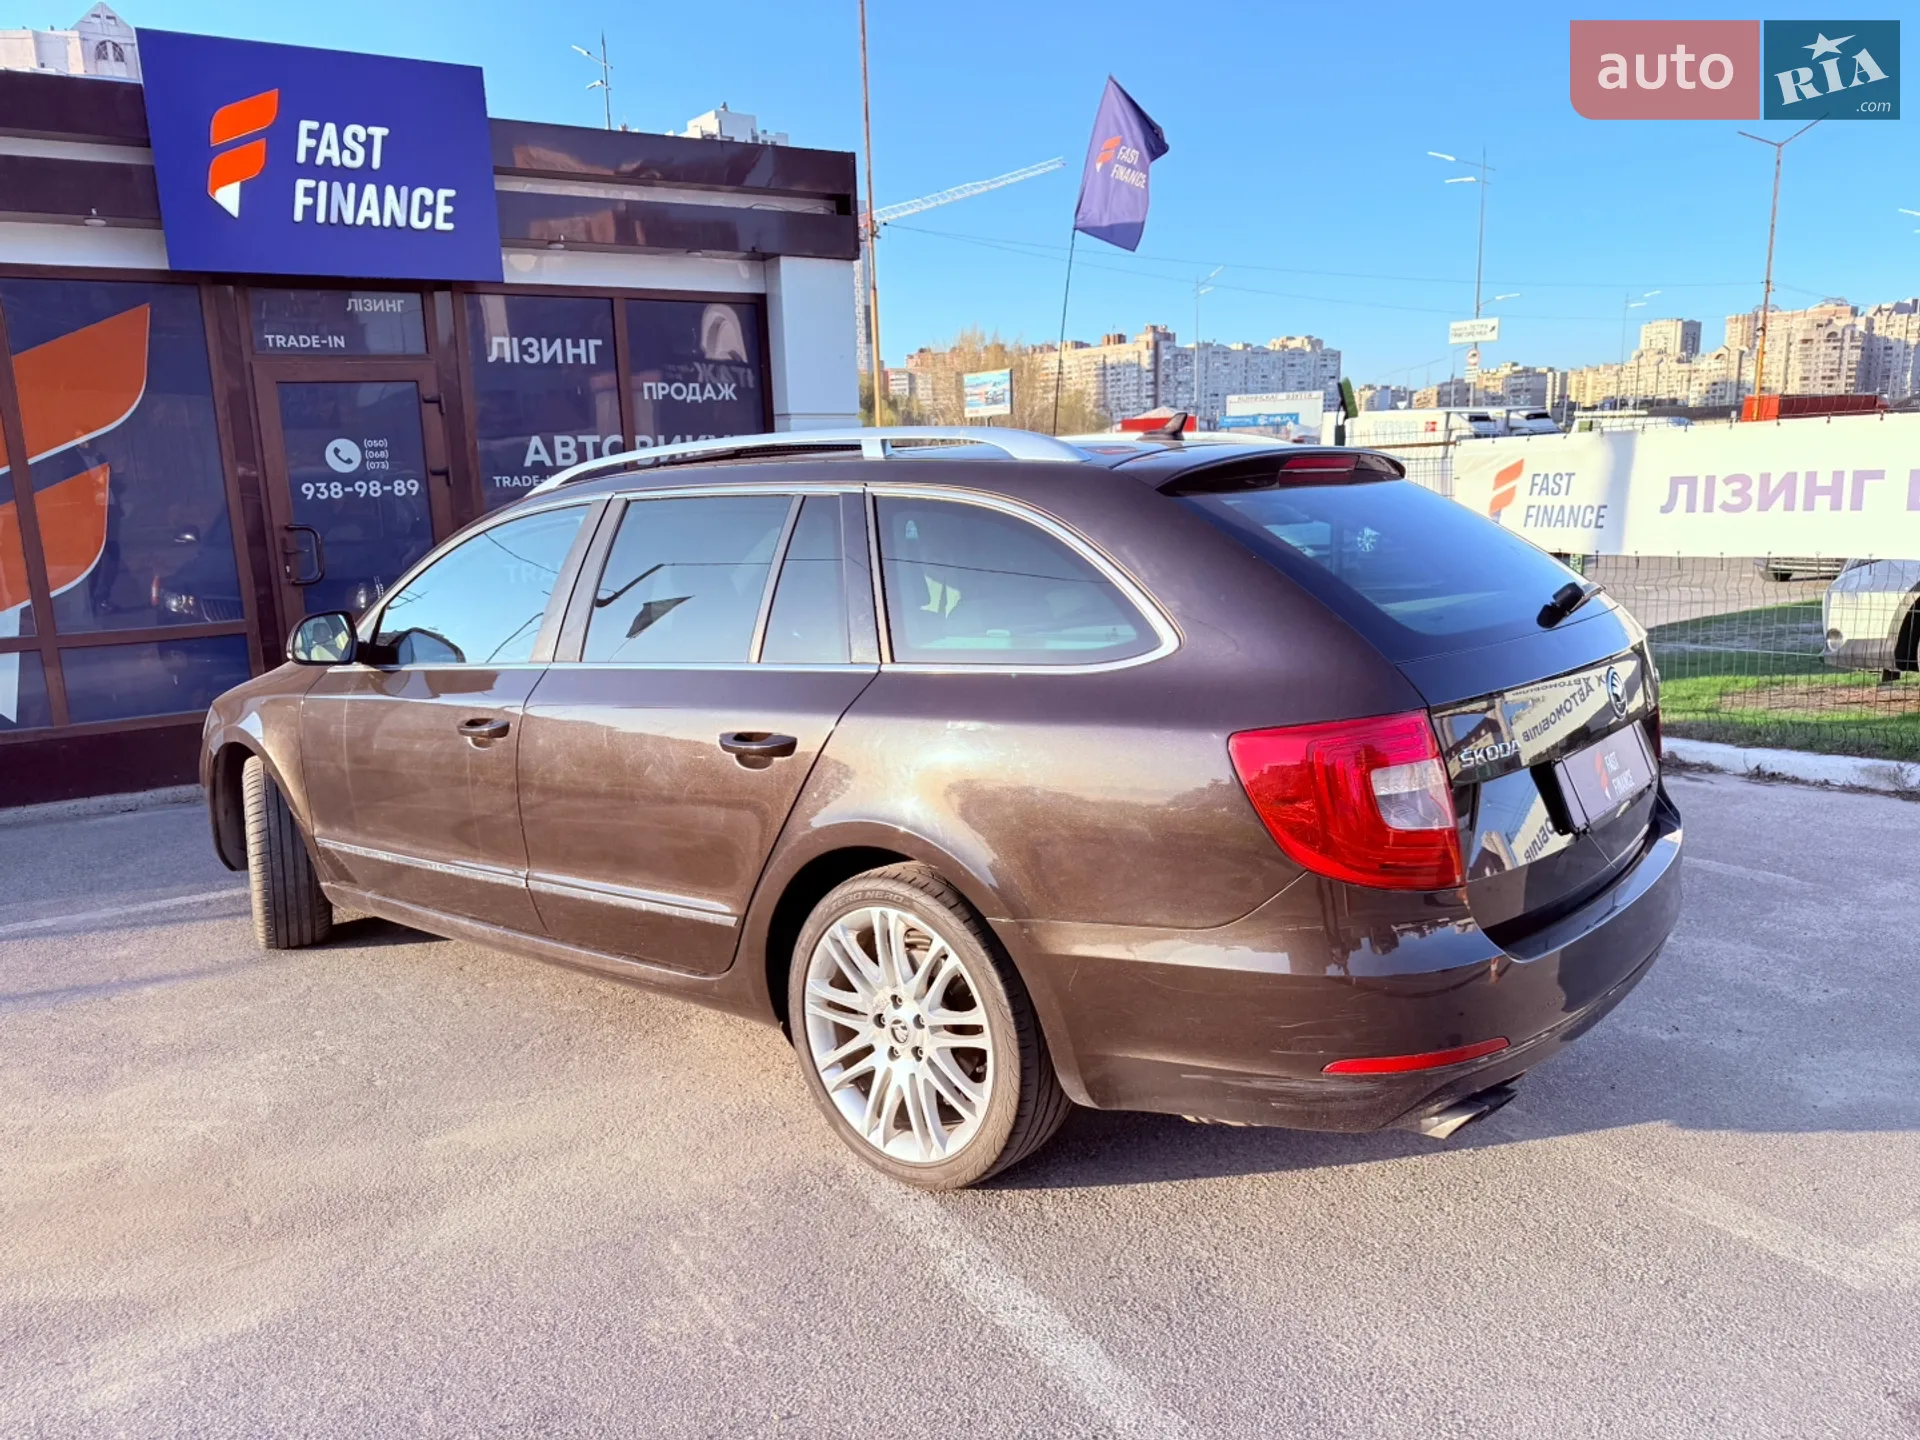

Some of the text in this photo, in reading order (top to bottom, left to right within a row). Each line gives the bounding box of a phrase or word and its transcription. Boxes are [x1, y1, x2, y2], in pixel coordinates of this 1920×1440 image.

[296, 119, 390, 170] FAST
[1117, 145, 1140, 165] FAST
[1110, 163, 1147, 189] FINANCE
[292, 178, 457, 232] FINANCE
[346, 297, 405, 314] ЛІЗИНГ
[264, 333, 346, 349] TRADE-IN
[486, 336, 603, 366] ЛІЗИНГ
[642, 381, 738, 404] ПРОДАЖ
[363, 438, 388, 448] (050)
[365, 449, 389, 459] (068)
[366, 460, 390, 470] (073)
[301, 478, 419, 500] 938-98-89
[1528, 472, 1575, 497] FAST
[1659, 469, 1886, 515] ЛІЗИНГ
[1523, 503, 1608, 530] FINANCE
